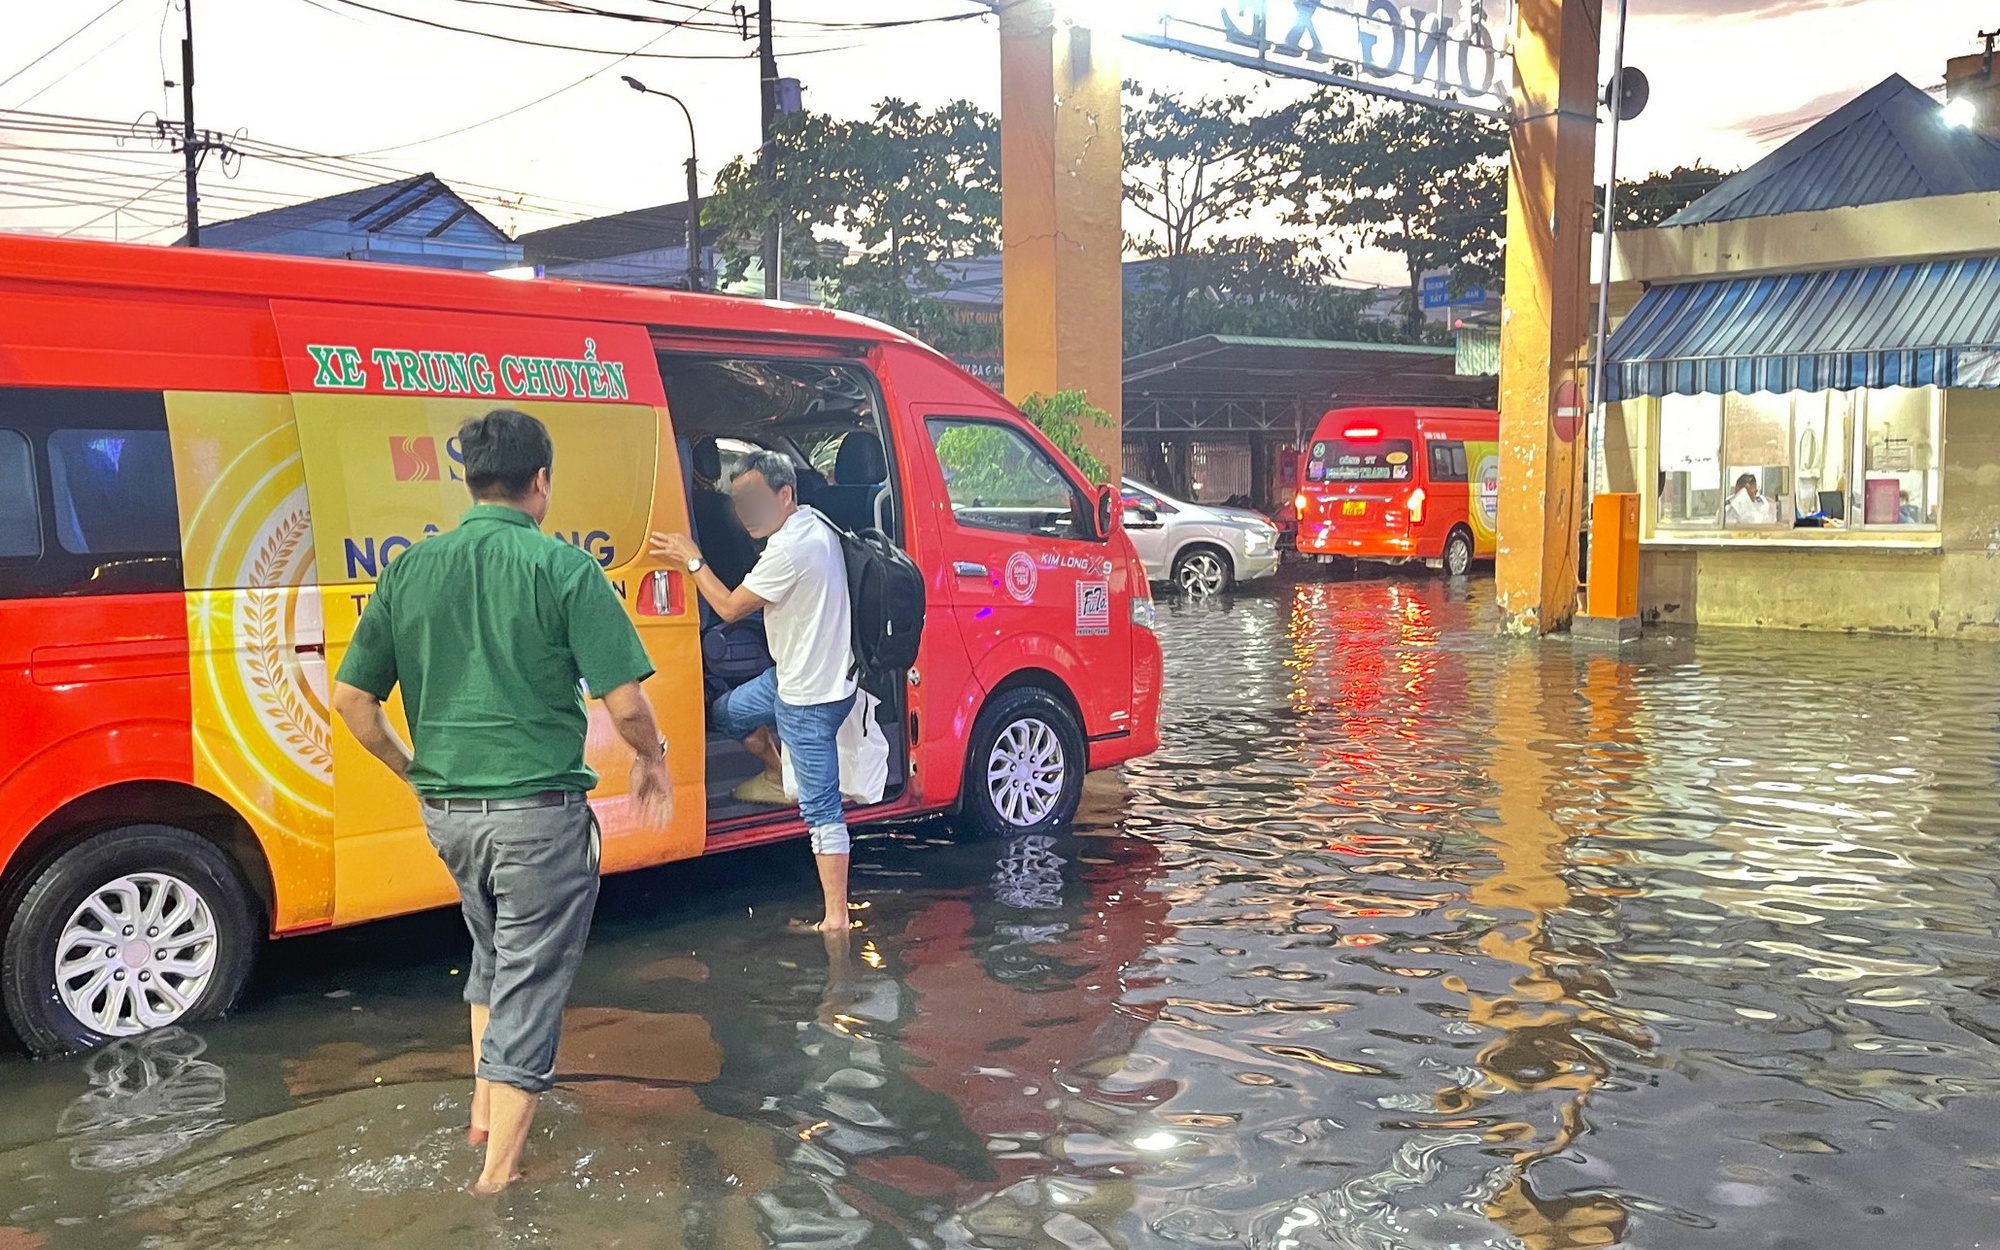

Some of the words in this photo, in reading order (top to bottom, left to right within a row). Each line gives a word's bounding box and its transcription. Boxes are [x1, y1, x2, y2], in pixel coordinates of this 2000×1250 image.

[308, 345, 366, 388] XE
[372, 348, 496, 394] TRUNG
[500, 338, 629, 399] CHUYỂN
[1040, 552, 1061, 566] KIM
[1060, 556, 1089, 570] LONG
